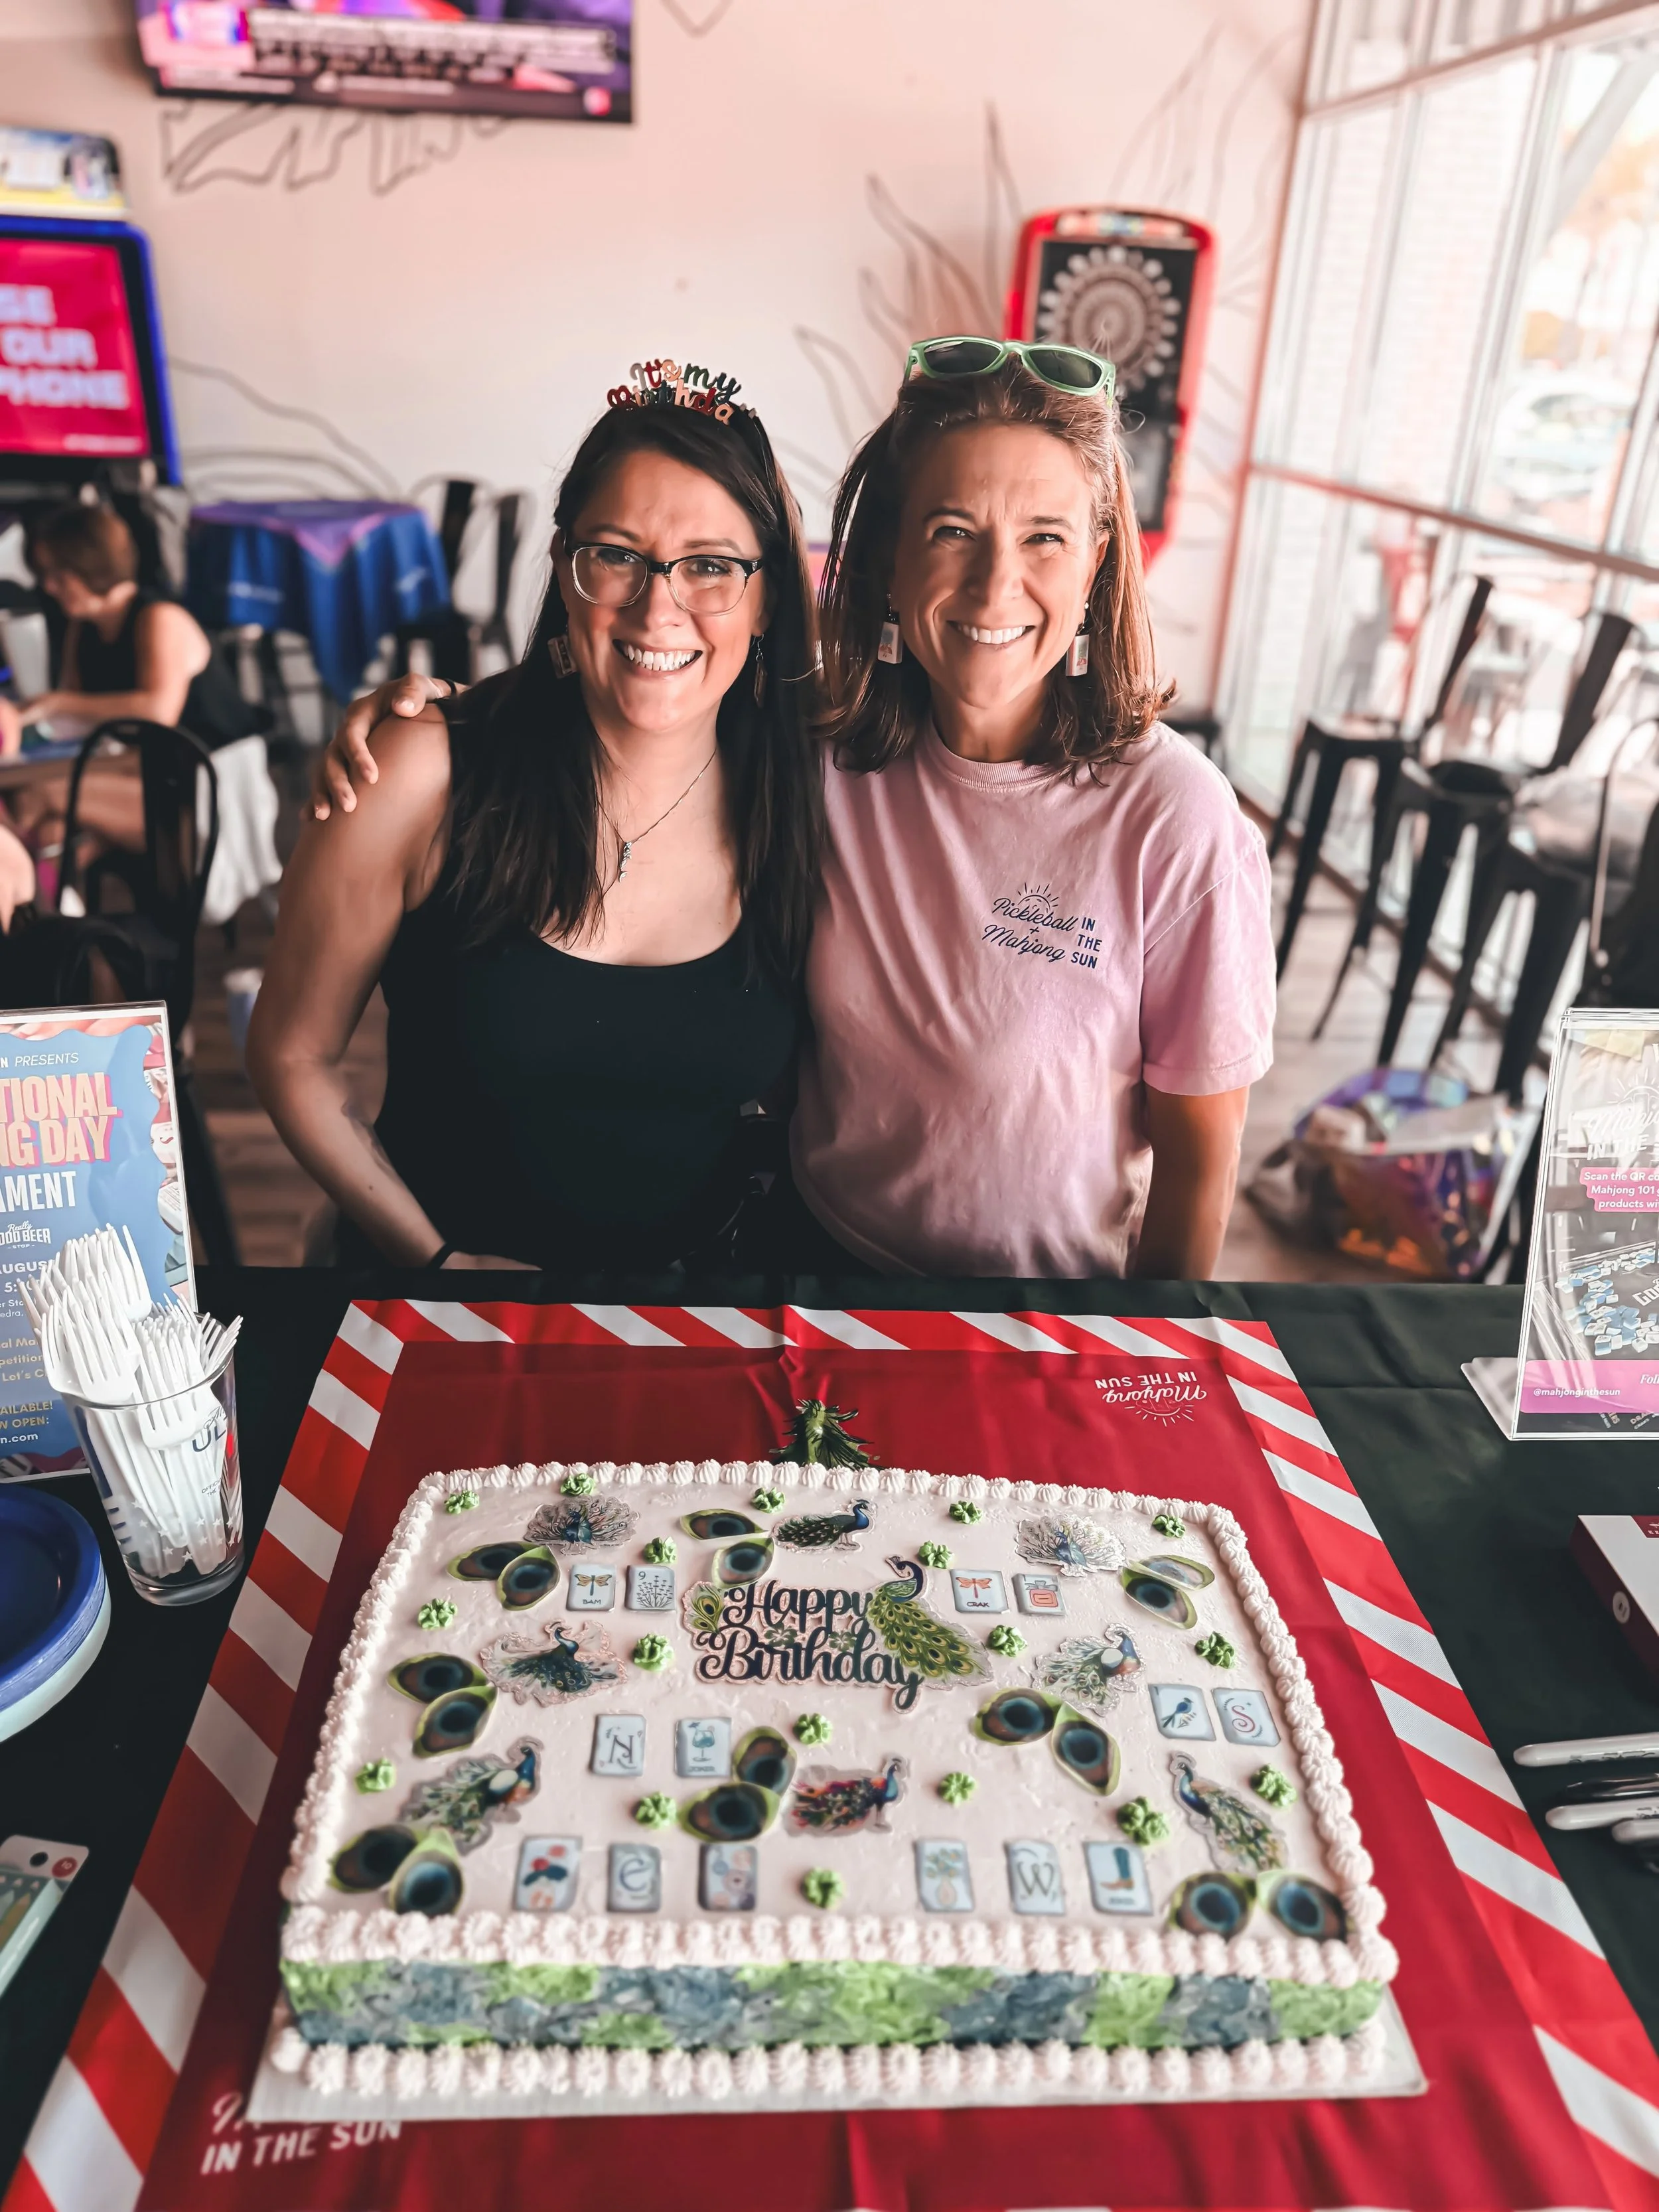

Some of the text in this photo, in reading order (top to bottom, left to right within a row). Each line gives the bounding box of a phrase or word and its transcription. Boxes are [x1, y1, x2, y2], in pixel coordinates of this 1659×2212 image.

[684, 363, 742, 404] my
[992, 898, 1079, 932] Pickleball
[1081, 917, 1096, 932] IN
[982, 925, 1066, 962] Mahjong
[1078, 934, 1102, 952] THE
[1070, 952, 1098, 969] SUN
[15, 1053, 79, 1067] PRESENTS
[39, 1116, 108, 1164] DAY
[1583, 1171, 1609, 1181] Scan
[1611, 1172, 1627, 1181] the
[1630, 1172, 1646, 1181] QR
[1591, 1185, 1655, 1197] Mahjong 101
[1598, 1199, 1644, 1211] products
[22, 1228, 51, 1244] BEER
[0, 1260, 49, 1274] UGUS
[0, 1337, 39, 1349] al Ma
[1095, 1371, 1197, 1389] IN THE SUN
[1102, 1384, 1207, 1403] Mahjong
[1534, 1387, 1621, 1398] @mahjonginthesun
[12, 1416, 49, 1428] OPEN:
[638, 1571, 646, 1581] 9
[723, 1580, 876, 1636] Happy
[696, 1618, 924, 1710] Birthday
[1232, 1705, 1256, 1733] S
[200, 2140, 242, 2175] IN
[252, 2126, 321, 2167] THE
